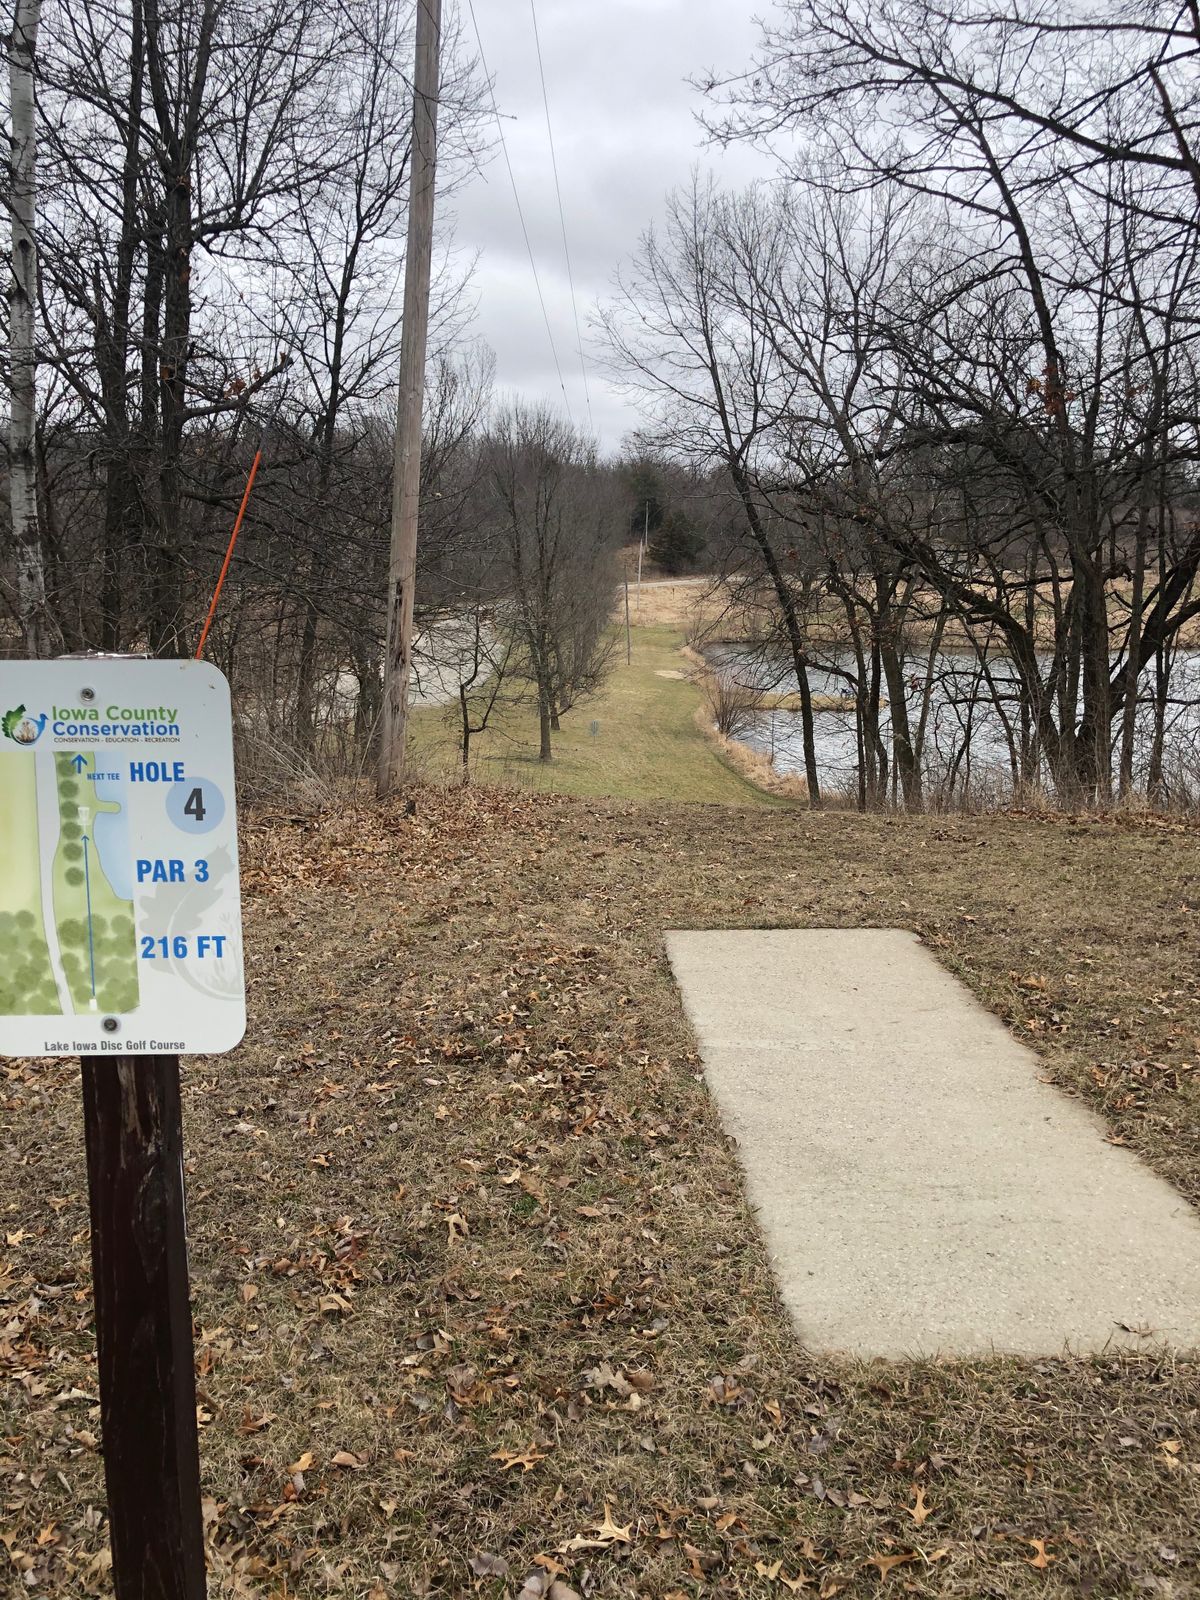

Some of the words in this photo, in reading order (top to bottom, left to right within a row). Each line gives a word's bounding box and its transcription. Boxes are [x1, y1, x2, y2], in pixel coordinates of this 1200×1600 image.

[52, 705, 99, 721] Iowa
[106, 705, 178, 723] County
[52, 721, 180, 736] Conservation
[87, 773, 106, 781] NEXT
[130, 762, 185, 782] HOLE
[184, 787, 206, 821] 4
[136, 859, 185, 883] PAR
[194, 859, 209, 882] 3
[141, 936, 187, 959] 216
[197, 936, 226, 958] FT
[44, 1041, 69, 1051] Lake
[73, 1041, 97, 1051] Iowa
[101, 1040, 123, 1050] Disc
[126, 1040, 146, 1050] Golf
[150, 1039, 185, 1050] Course
